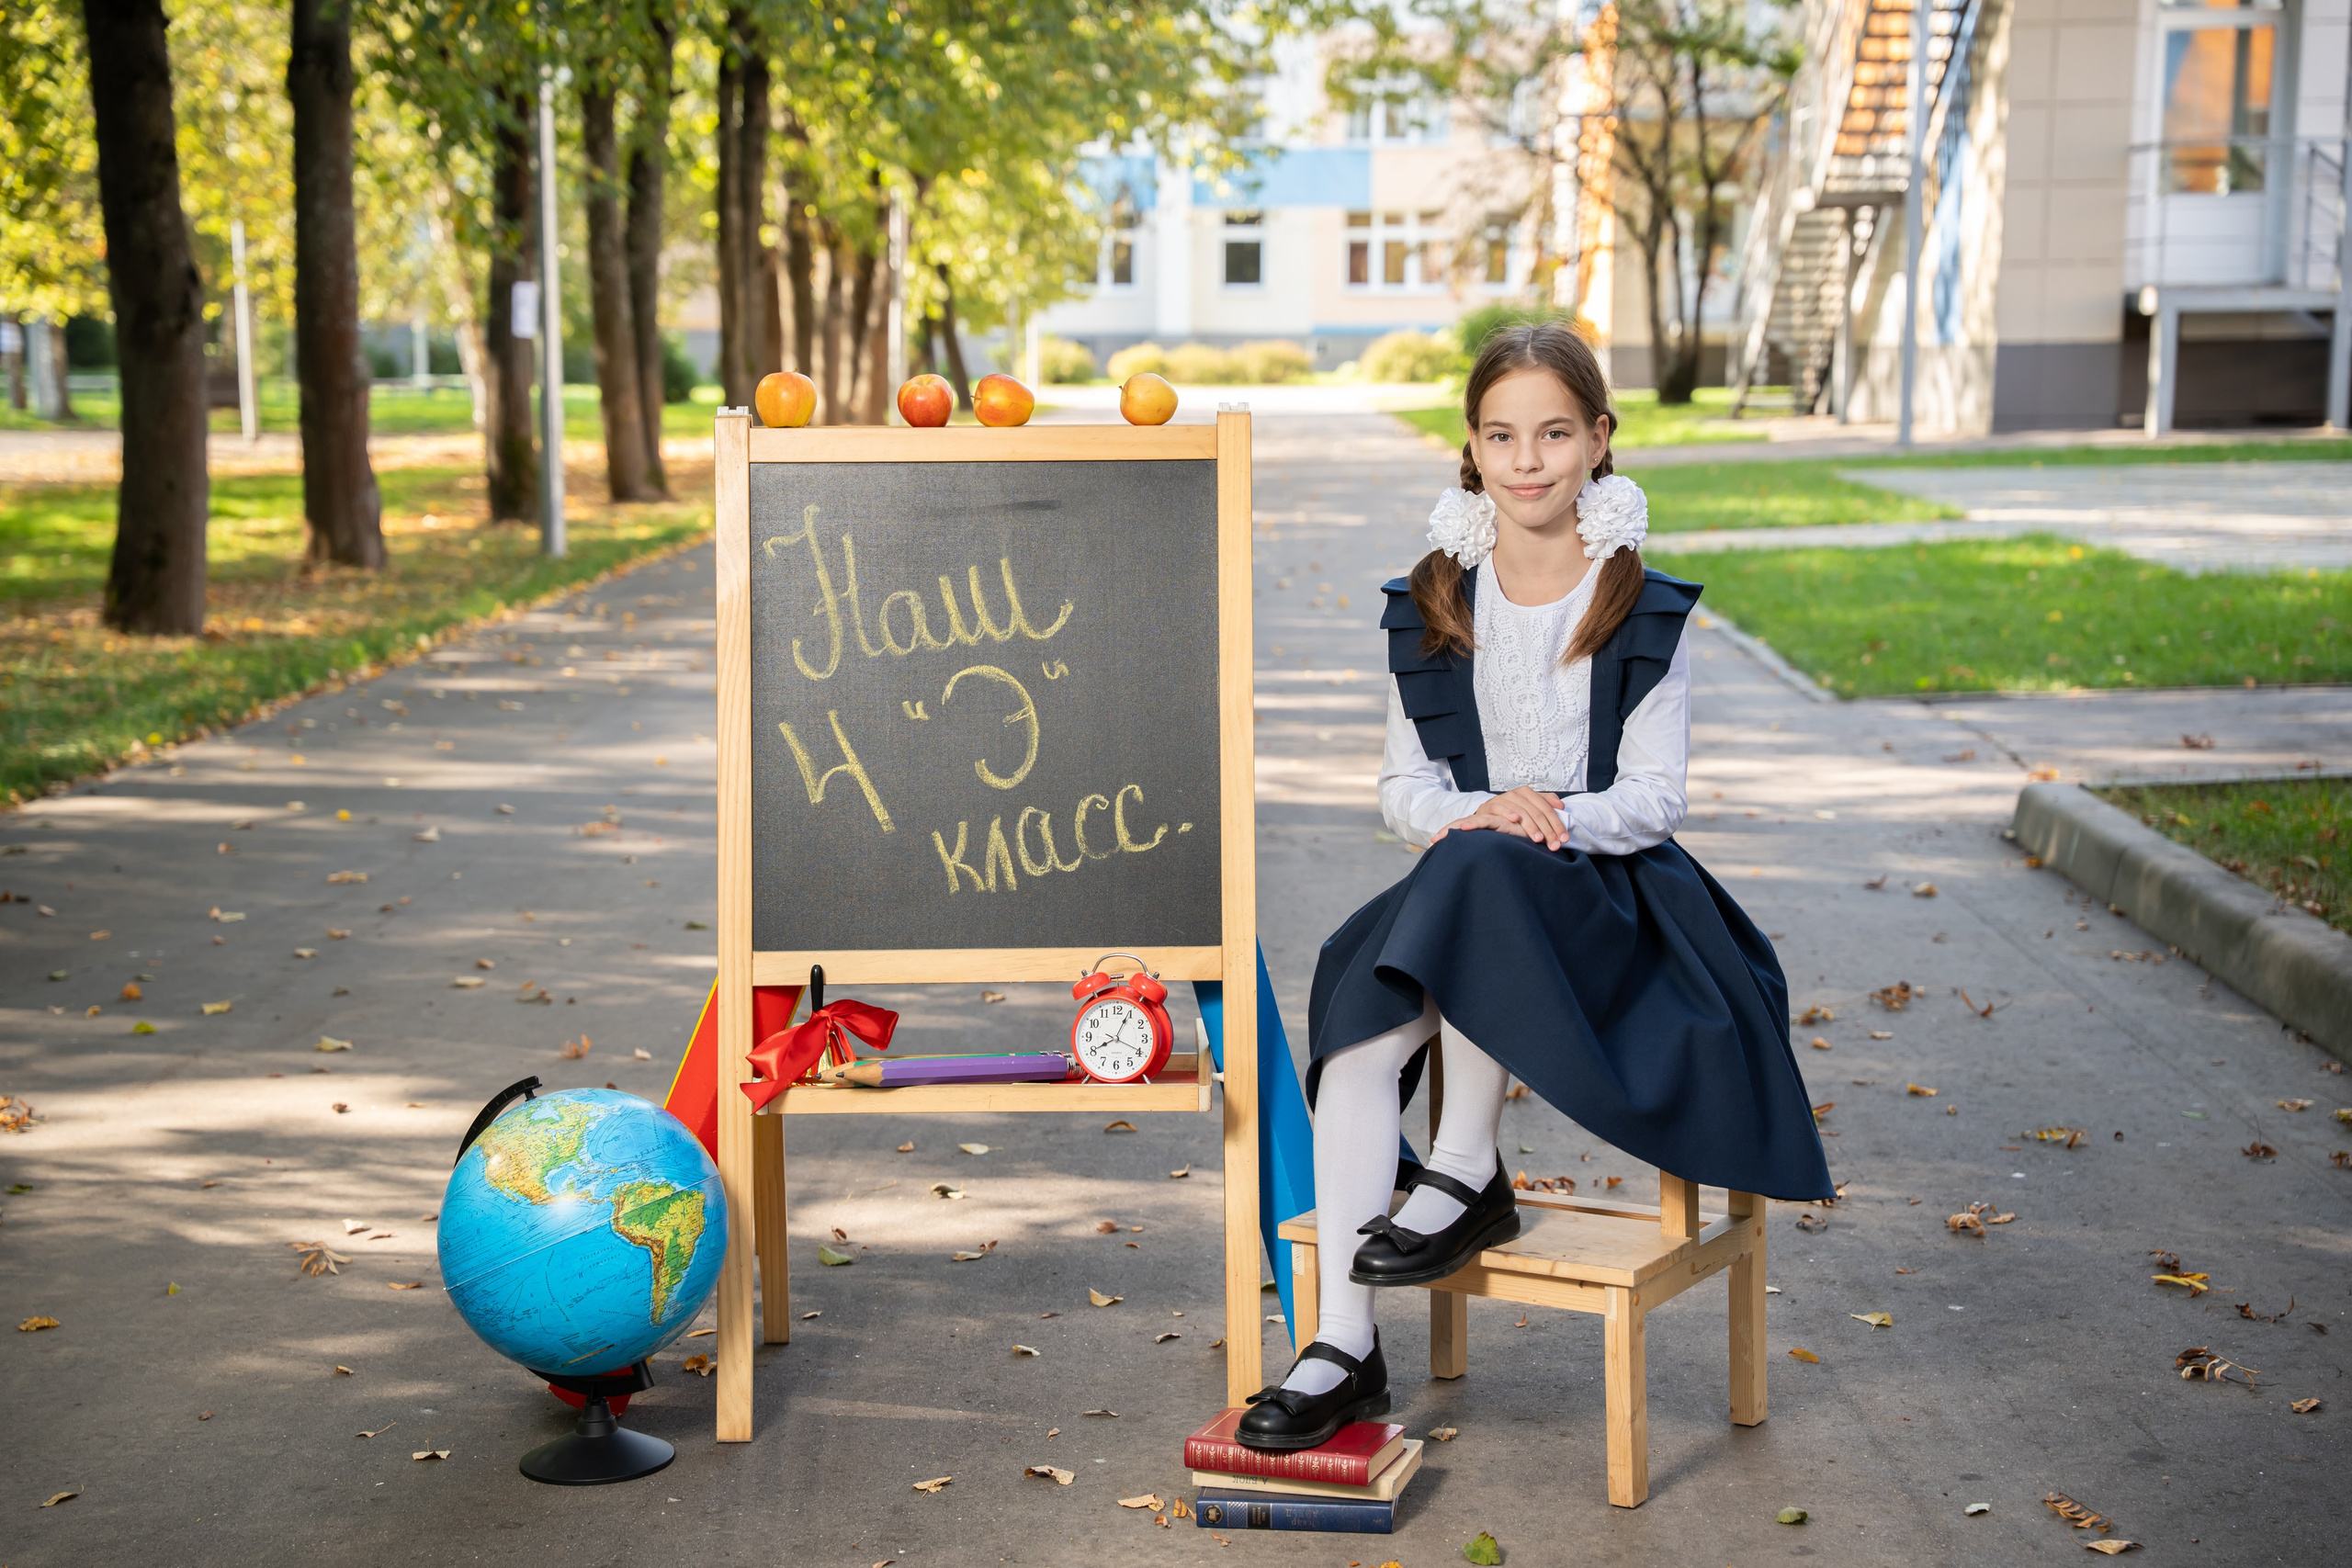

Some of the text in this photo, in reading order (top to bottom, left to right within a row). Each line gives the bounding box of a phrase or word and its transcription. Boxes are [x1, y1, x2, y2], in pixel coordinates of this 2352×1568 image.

[762, 503, 1074, 682] Наш
[931, 784, 1193, 894] класс.
[1100, 1009, 1108, 1018] 11
[1113, 1005, 1123, 1015] 12
[1090, 1019, 1099, 1028] 10
[1138, 1020, 1144, 1029] 2
[1086, 1032, 1092, 1043] 9
[1142, 1033, 1148, 1044] 3
[1090, 1045, 1097, 1056] 8
[1136, 1047, 1142, 1057] 4
[1100, 1056, 1107, 1066] 7
[1113, 1060, 1119, 1070] 6
[1127, 1057, 1133, 1067] 5
[1233, 1474, 1257, 1484] БЛОК
